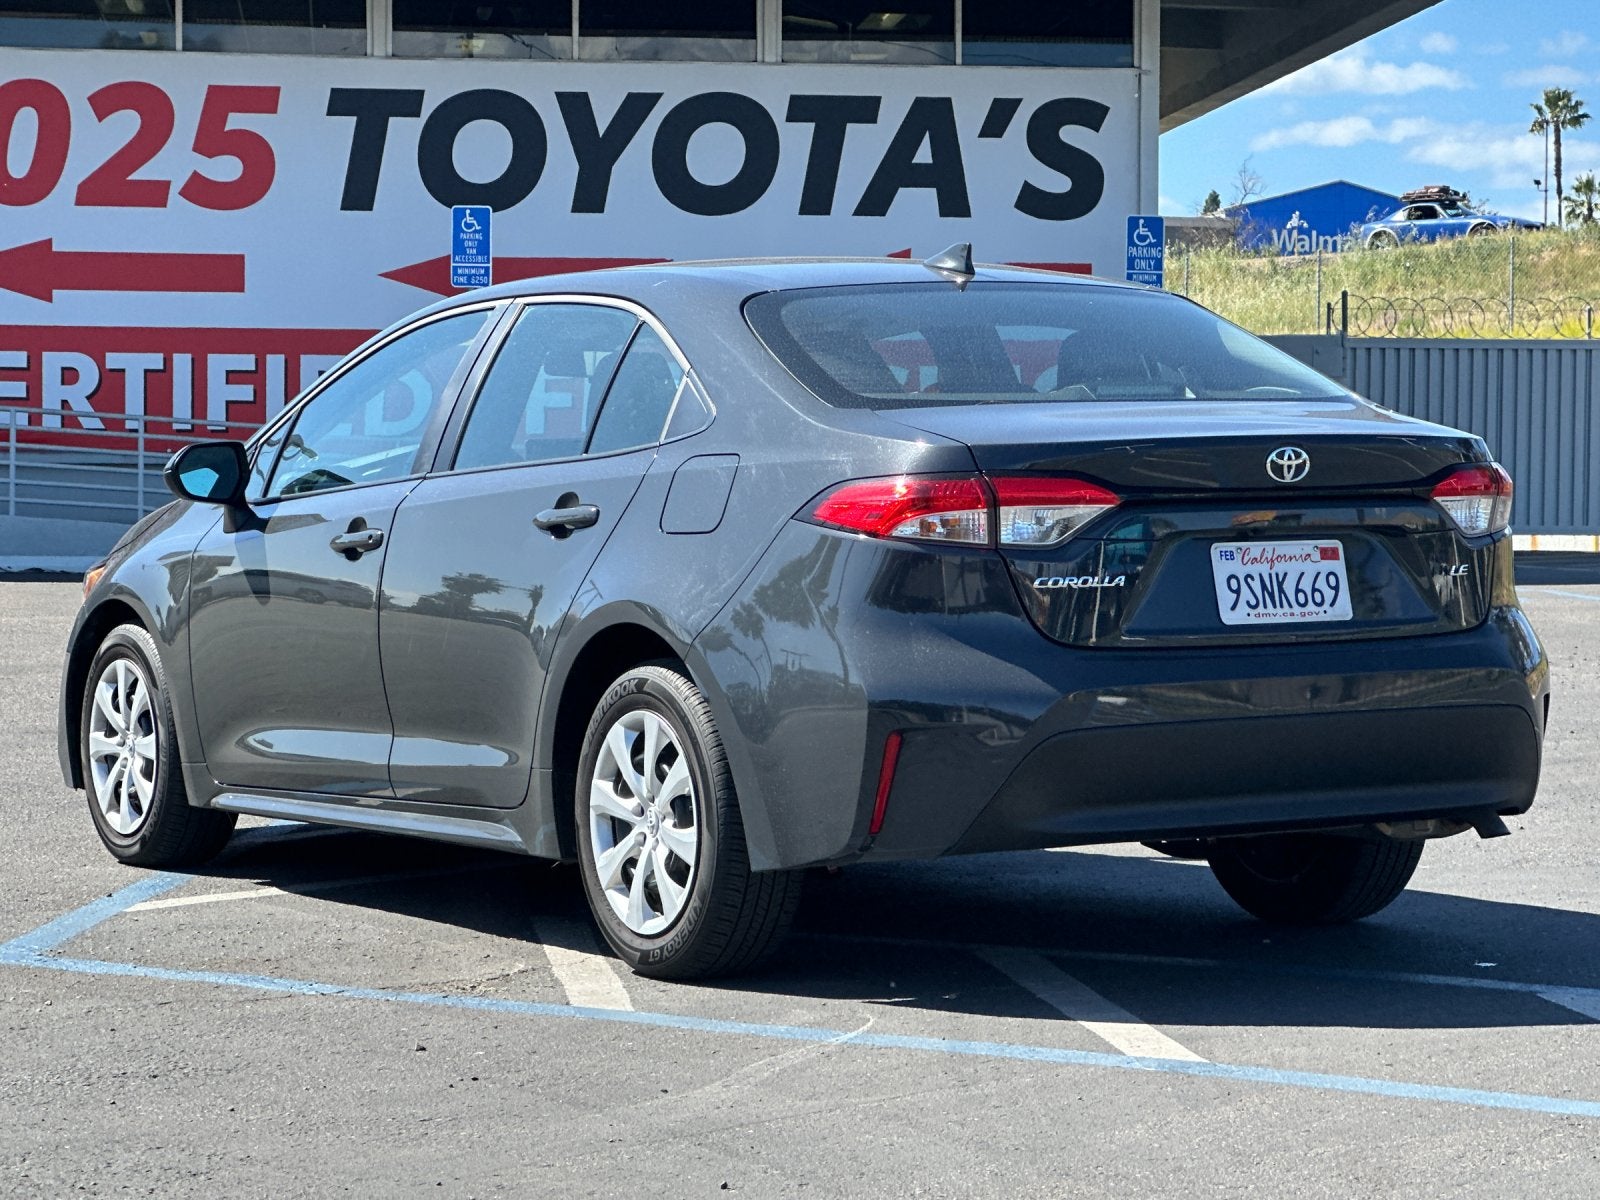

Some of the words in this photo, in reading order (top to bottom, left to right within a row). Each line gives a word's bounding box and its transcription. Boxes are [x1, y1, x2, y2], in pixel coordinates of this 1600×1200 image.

[0, 78, 281, 211] 025
[326, 87, 1110, 221] TOYOTA'S
[460, 232, 483, 240] PARKING
[1128, 246, 1162, 258] PARKING
[455, 255, 488, 263] ACCESSIBLE
[1134, 259, 1156, 271] ONLY
[457, 267, 485, 275] MINIMUM
[453, 276, 468, 284] FINE
[470, 276, 488, 284] $250
[1132, 274, 1157, 282] MINIMUM
[1219, 550, 1236, 561] FEB
[1241, 547, 1318, 570] California
[1450, 564, 1469, 576] LE
[1032, 575, 1126, 589] COROLLA
[1226, 571, 1340, 611] 9SNK669
[1254, 610, 1321, 619] dmv.ca.gov
